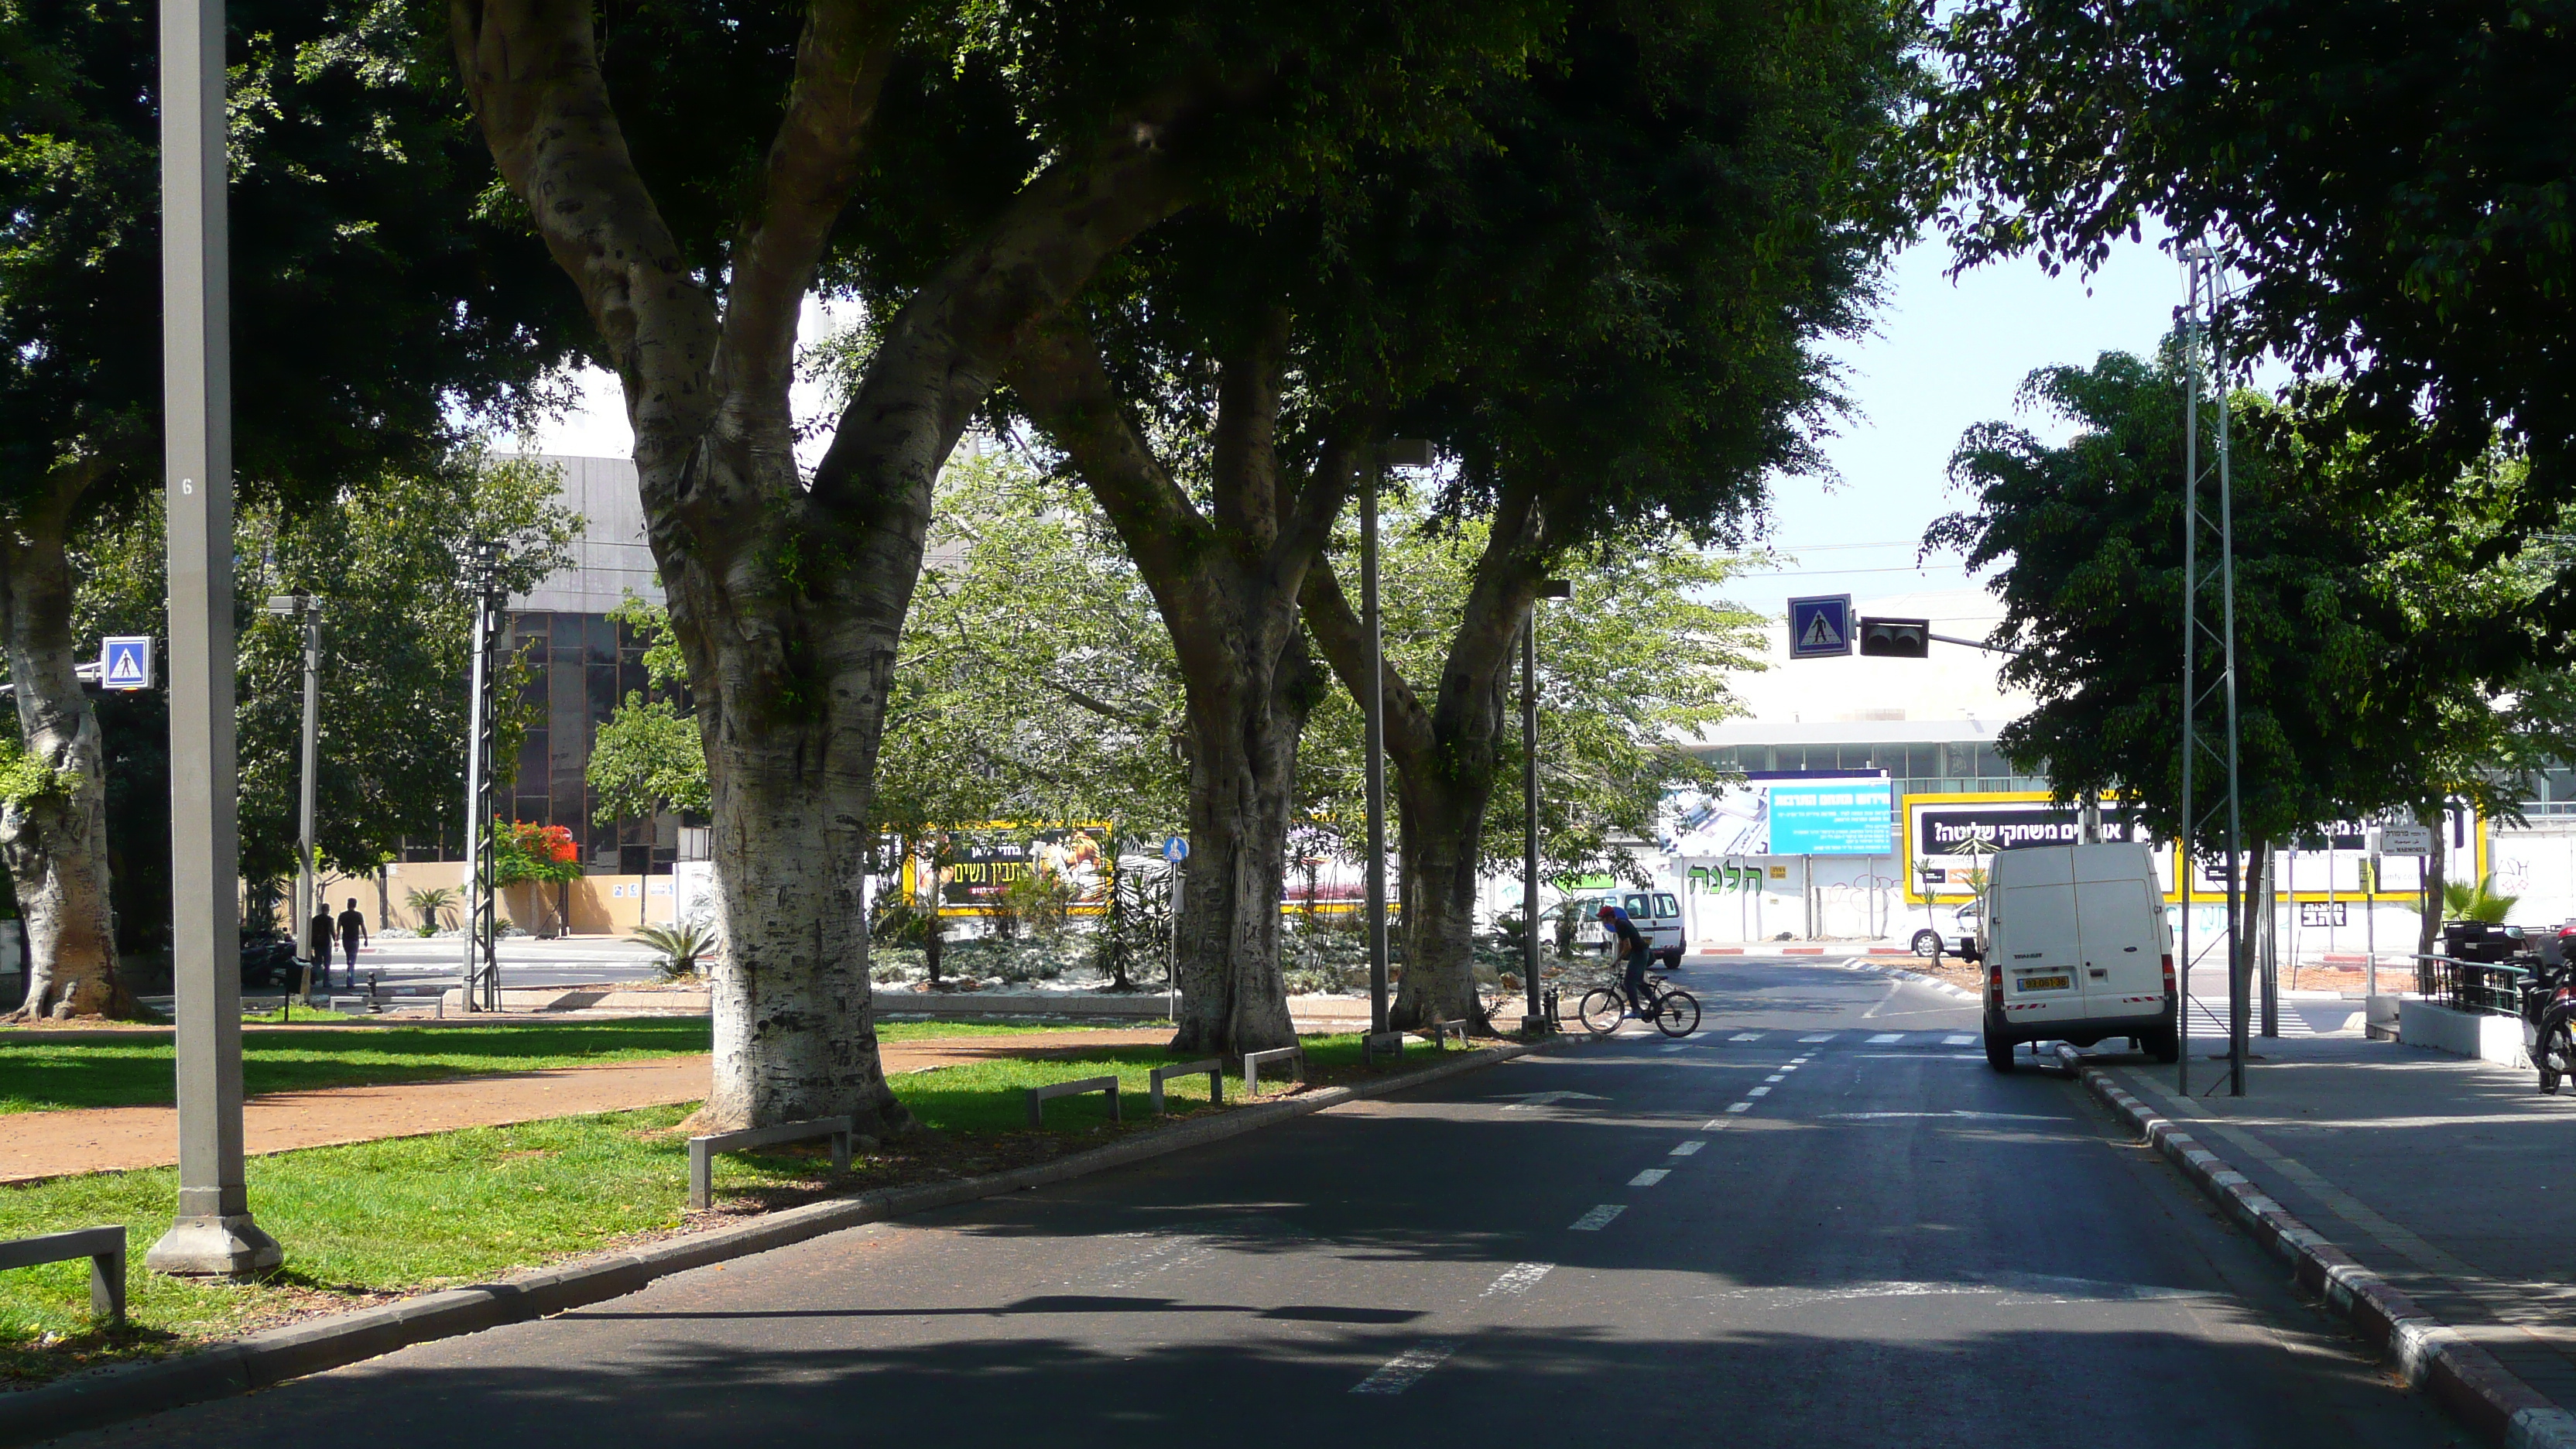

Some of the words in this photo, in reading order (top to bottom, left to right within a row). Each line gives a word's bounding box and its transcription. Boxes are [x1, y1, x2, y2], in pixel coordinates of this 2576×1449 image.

[183, 478, 192, 495] 6
[1934, 821, 1995, 841] שליטה?
[1999, 824, 2058, 846] משחקי
[2060, 823, 2121, 840] אוים
[954, 862, 986, 882] נשים
[1687, 859, 1762, 896] הלנה
[2304, 903, 2344, 912] חצות
[2304, 912, 2345, 926] זהב
